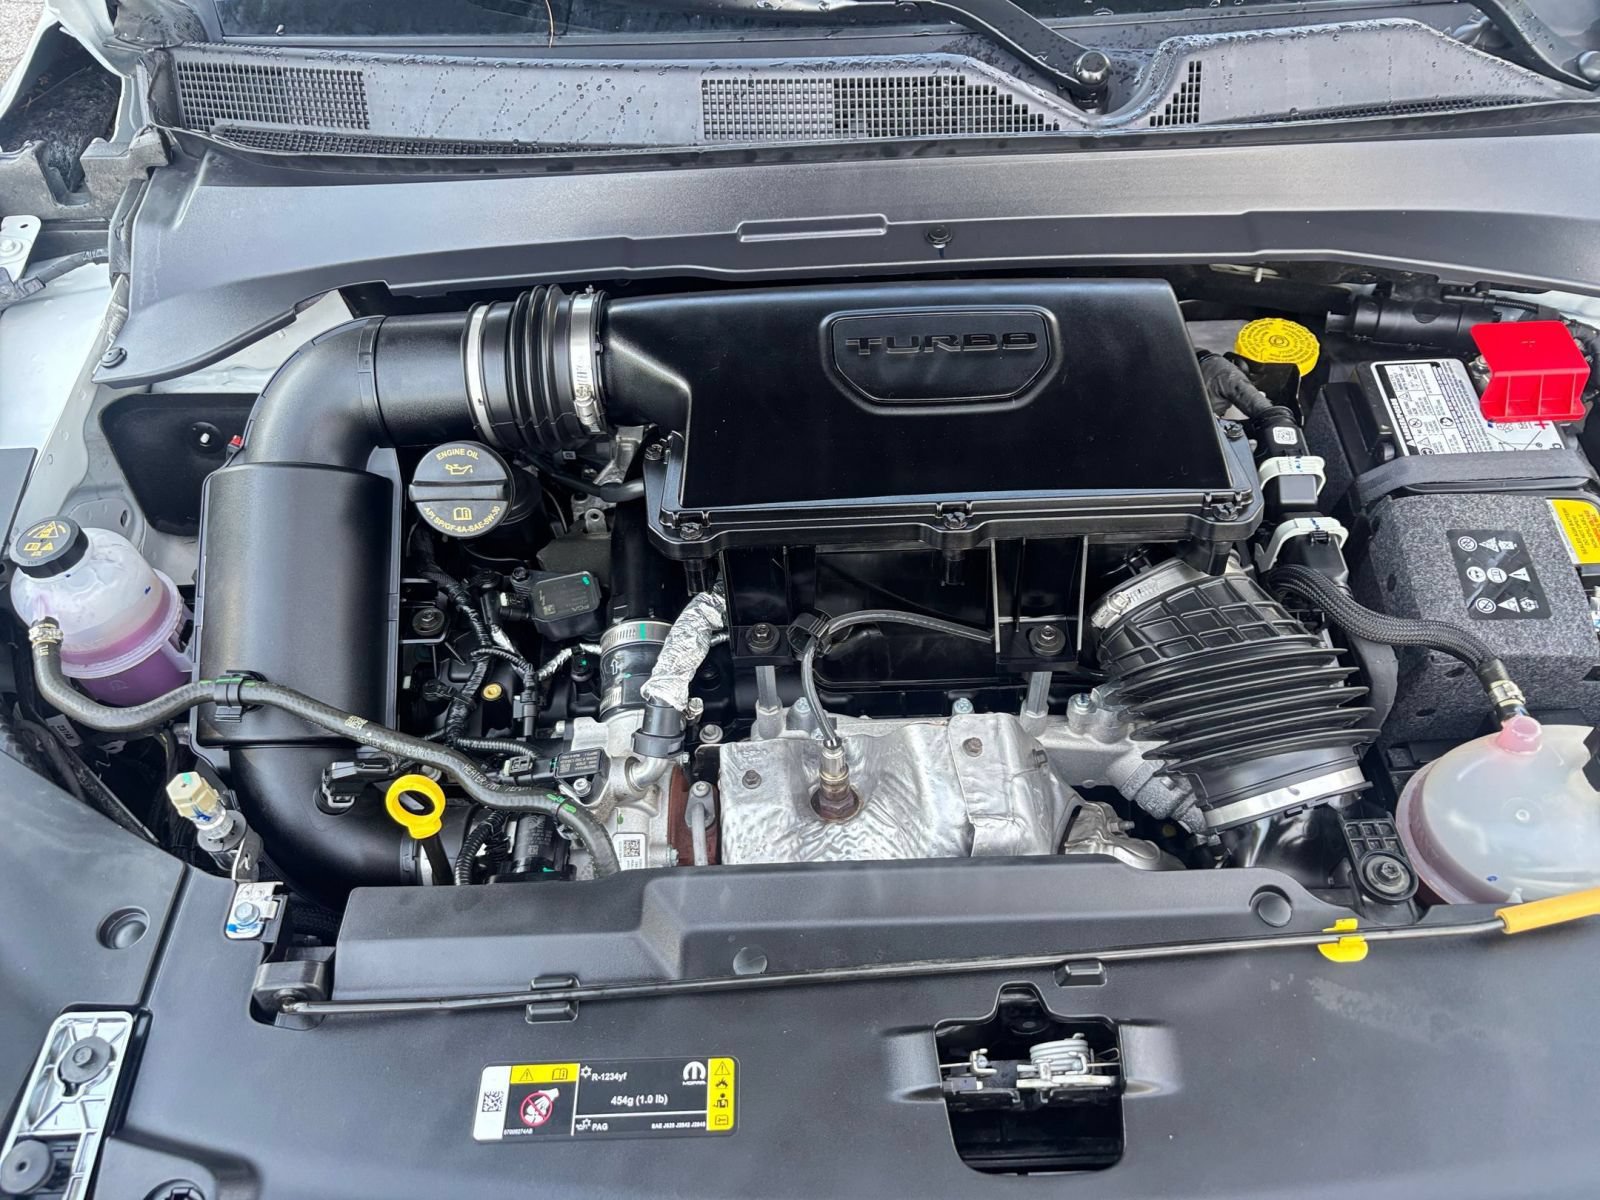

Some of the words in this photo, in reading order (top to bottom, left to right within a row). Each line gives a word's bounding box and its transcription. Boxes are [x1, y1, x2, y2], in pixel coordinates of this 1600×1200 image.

[436, 448, 465, 460] ENGINE
[466, 449, 479, 460] OIL
[463, 763, 487, 785] HEATER
[592, 1072, 628, 1082] R-1234yf
[611, 1096, 634, 1107] 454g
[636, 1095, 654, 1106] (1.0
[655, 1094, 669, 1105] lb)
[592, 1123, 608, 1131] PAG
